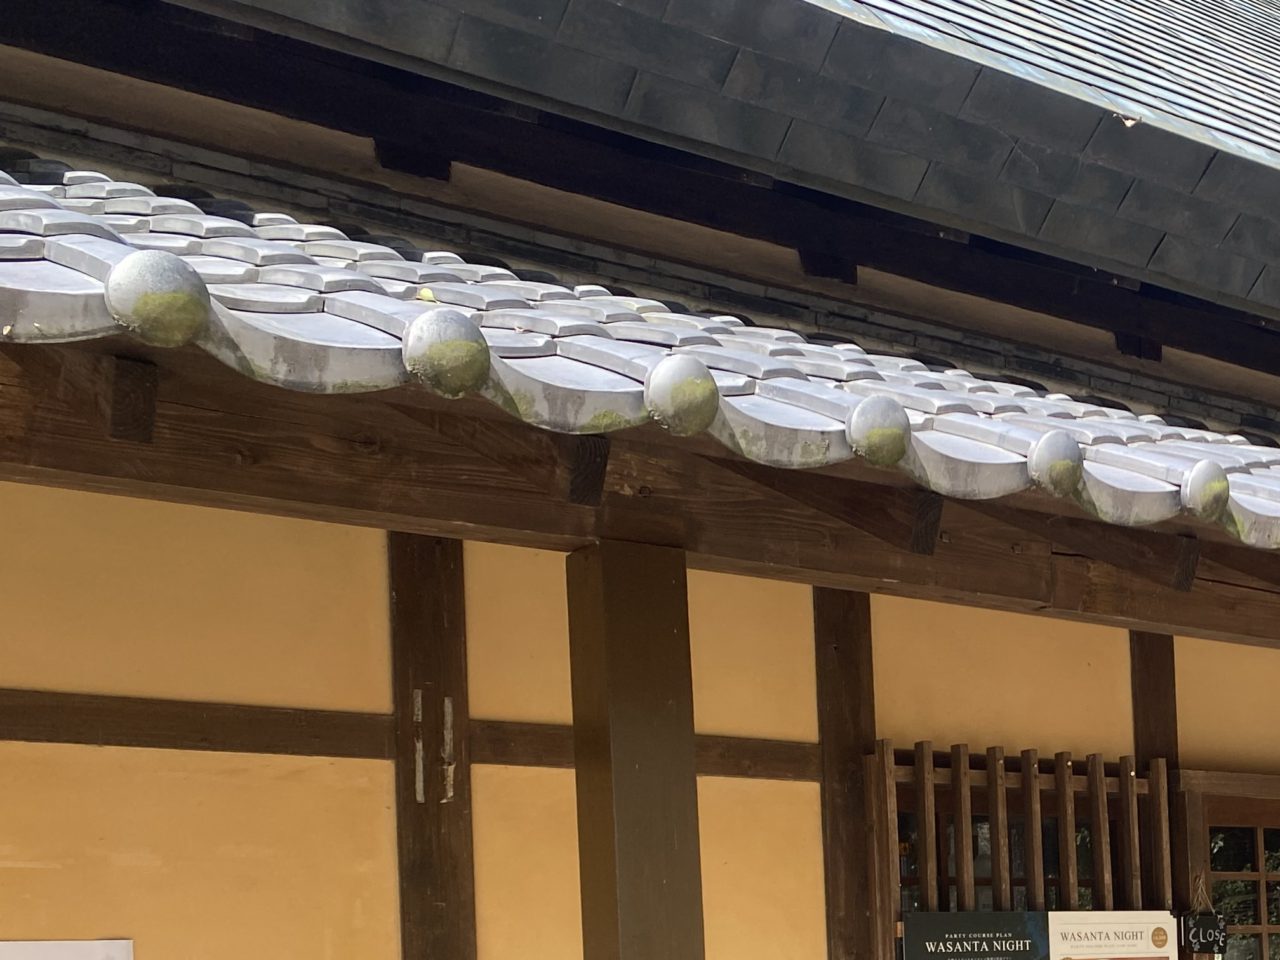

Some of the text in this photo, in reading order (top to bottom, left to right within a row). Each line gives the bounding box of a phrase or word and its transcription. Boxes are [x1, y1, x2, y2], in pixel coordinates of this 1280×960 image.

[1060, 931, 1111, 942] WASANTA
[1113, 930, 1145, 942] NIGHT
[1189, 927, 1226, 947] CLOSE
[925, 939, 1032, 953] WASANTA NIGHT
